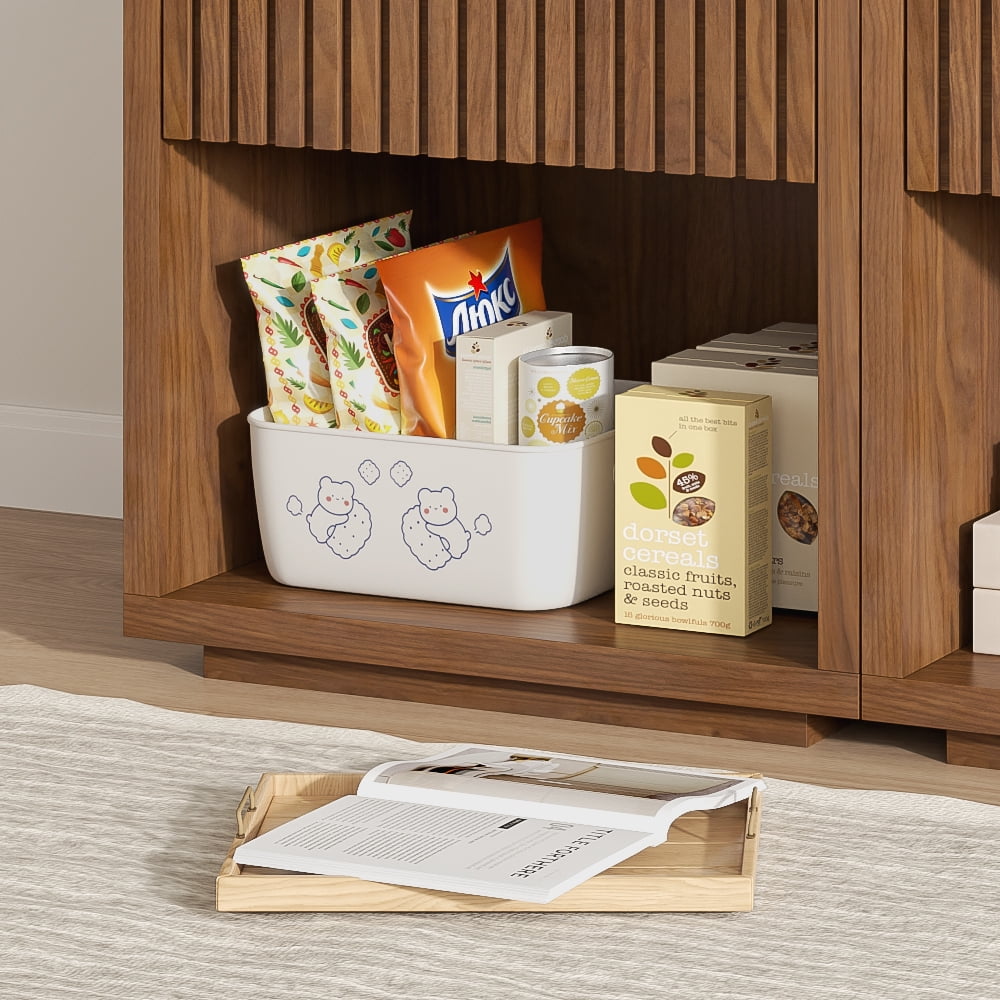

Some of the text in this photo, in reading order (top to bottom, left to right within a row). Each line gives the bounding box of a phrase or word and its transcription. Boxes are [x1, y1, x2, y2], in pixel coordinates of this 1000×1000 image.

[540, 413, 582, 426] Cupcake
[552, 422, 577, 434] Mix
[690, 416, 704, 424] the
[622, 522, 708, 548] dorset
[622, 546, 720, 569] cereals
[624, 565, 737, 588] classic fruits,
[624, 580, 731, 600] roasted nuts
[624, 592, 688, 610] & seeds
[635, 612, 670, 622] glorious
[672, 616, 708, 626] bowlfuls
[709, 620, 732, 630] 700g
[572, 830, 613, 846] TITLE
